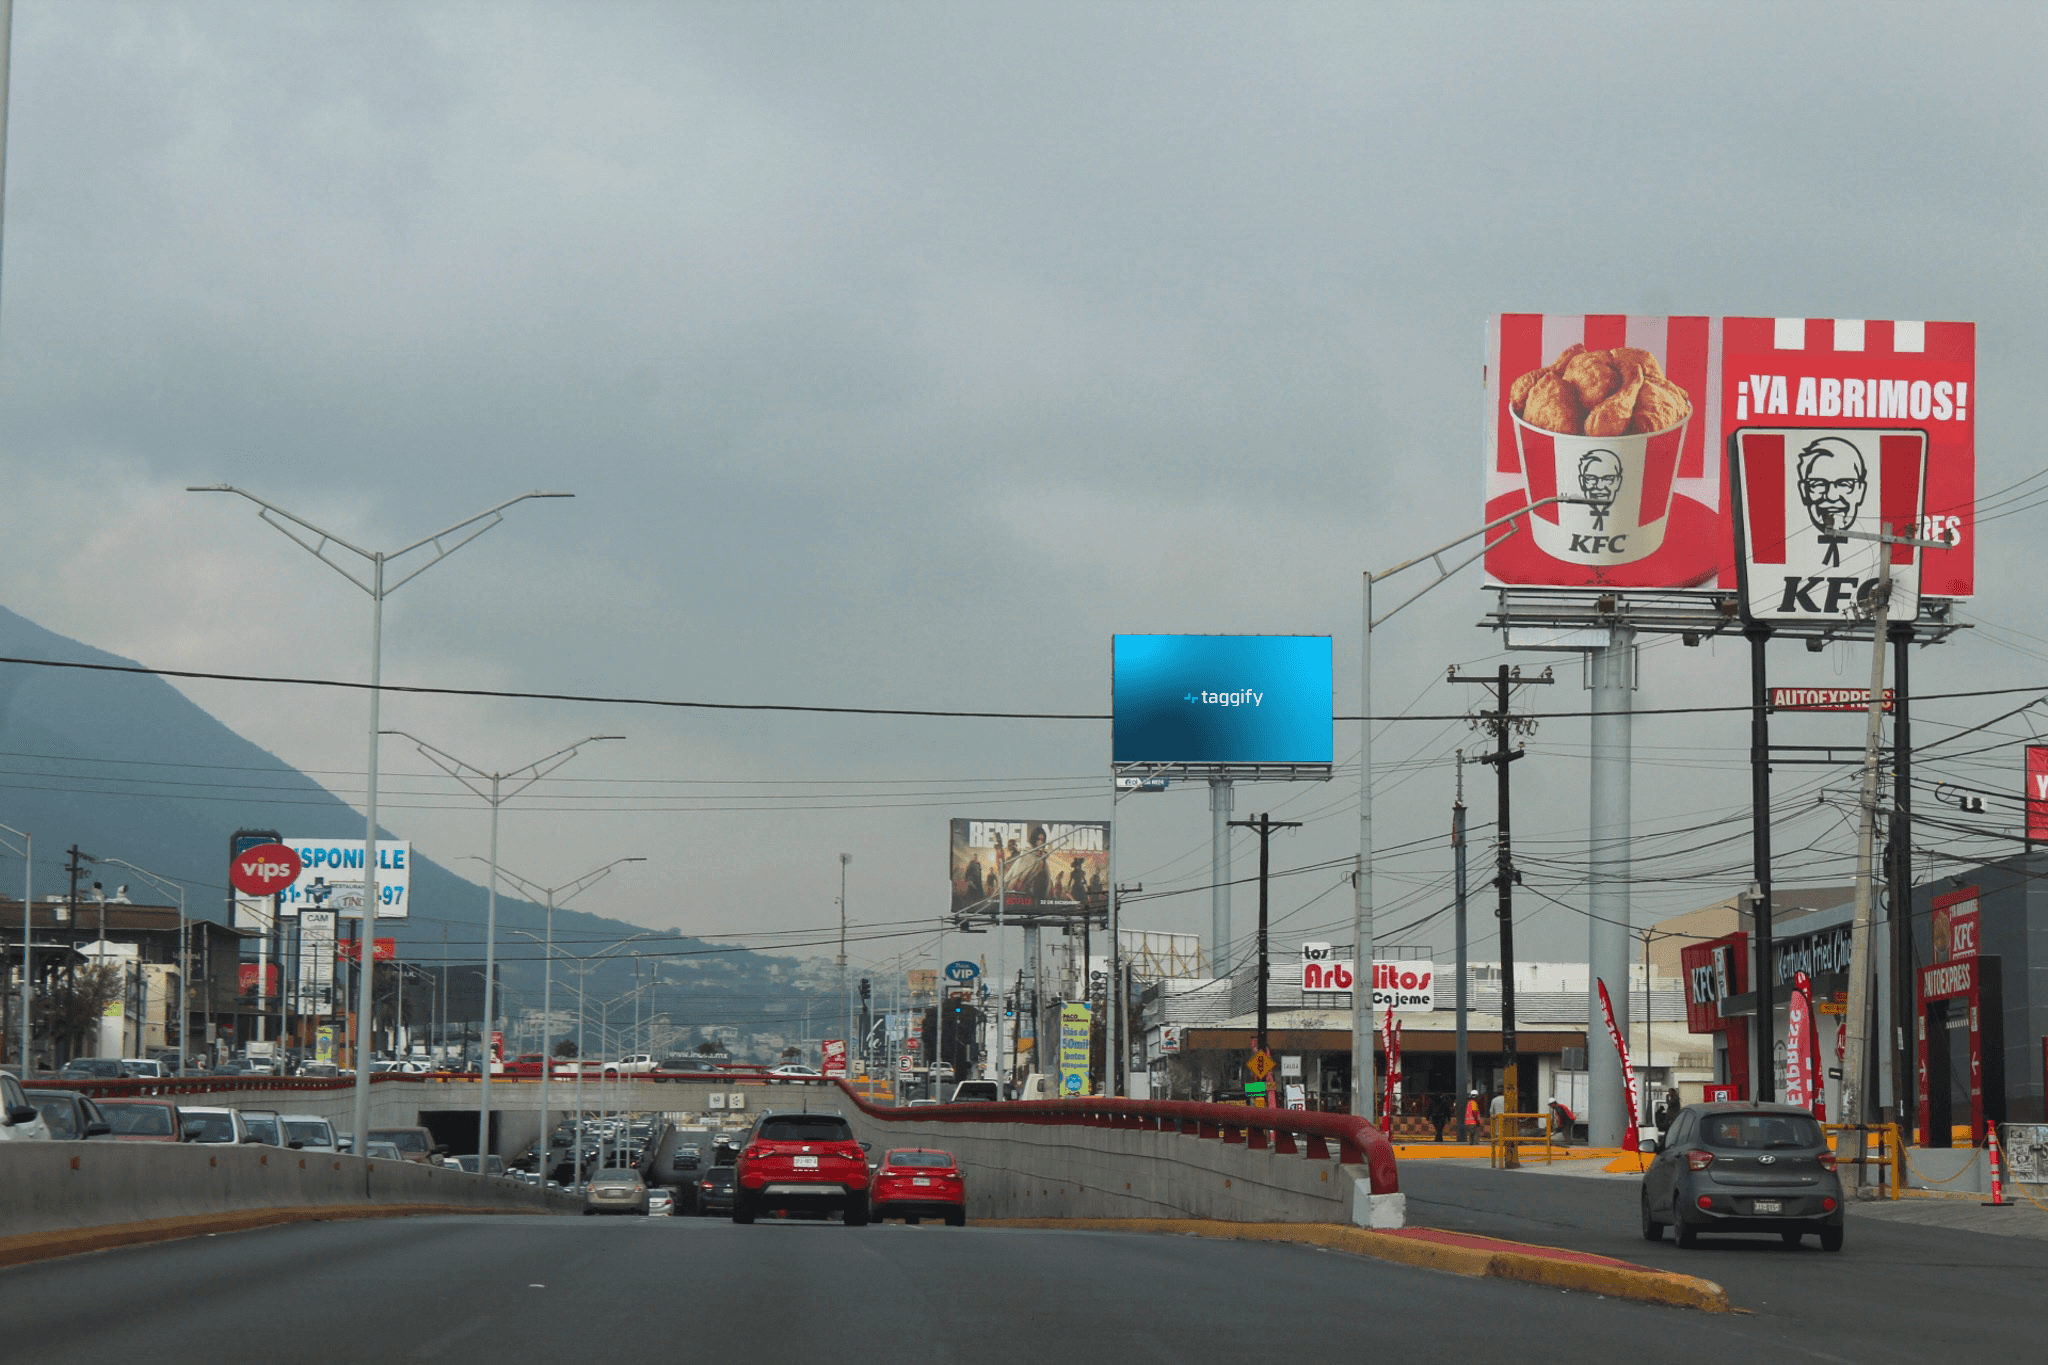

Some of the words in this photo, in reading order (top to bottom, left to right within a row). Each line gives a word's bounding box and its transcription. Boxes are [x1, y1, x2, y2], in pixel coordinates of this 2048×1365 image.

[1736, 374, 1789, 421] ¡YA
[1795, 376, 1968, 421] ABRIMOS!
[1568, 532, 1628, 554] KFC
[1201, 688, 1263, 707] taggify
[1774, 688, 1891, 708] AUTOEXPRES
[241, 857, 290, 882] vips
[295, 847, 405, 869] SPONILE
[1953, 921, 1974, 952] KFC
[952, 968, 974, 979] VIP
[1304, 963, 1432, 990] Arblitos
[1691, 965, 1715, 1004] KFC
[1923, 963, 1971, 998] AUTOEXPRESS
[1372, 991, 1431, 1008] Cajeme
